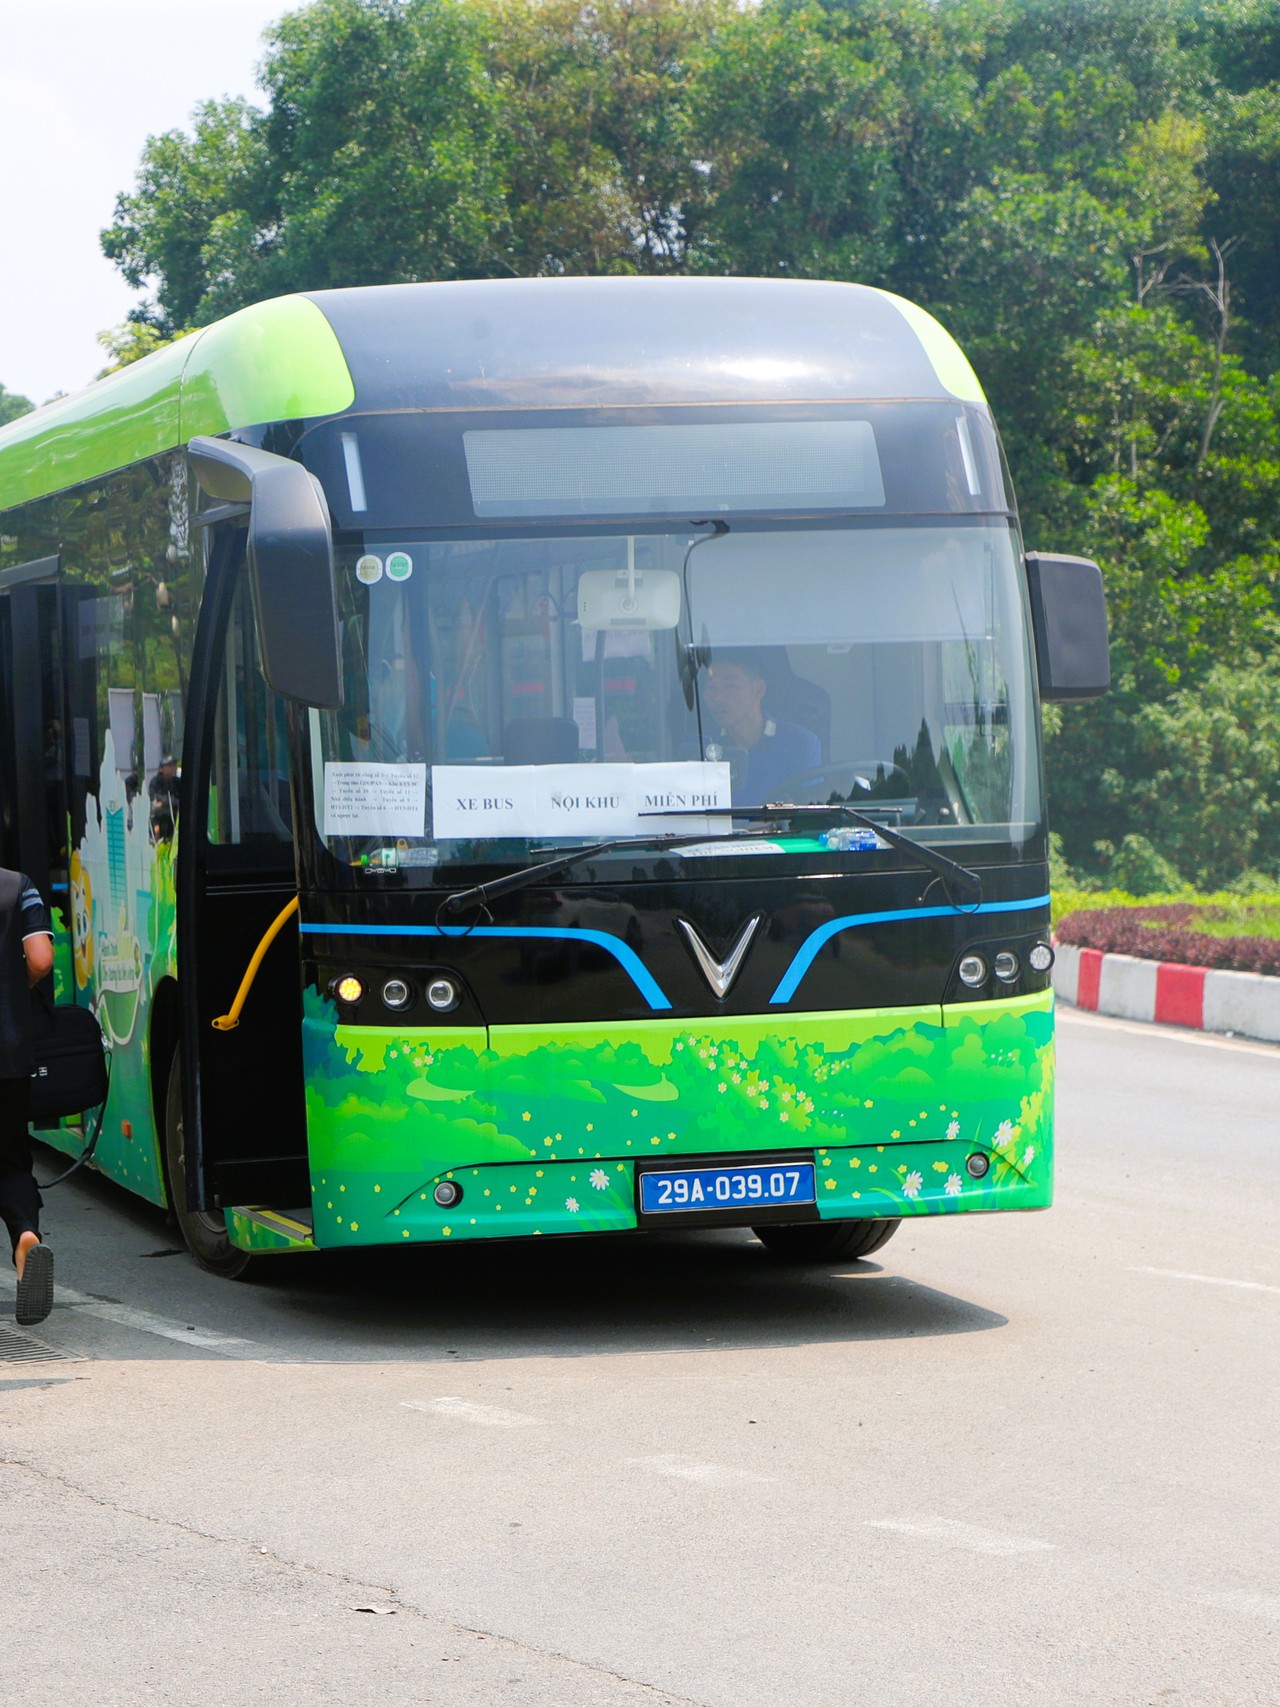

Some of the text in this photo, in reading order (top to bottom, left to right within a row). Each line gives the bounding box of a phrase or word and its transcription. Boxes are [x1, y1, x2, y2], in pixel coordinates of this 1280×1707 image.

[456, 798, 478, 810] XE
[483, 798, 514, 810] BUS
[585, 796, 621, 809] KHU
[691, 791, 718, 807] PHÍ
[657, 1171, 800, 1205] 29A-039.07
